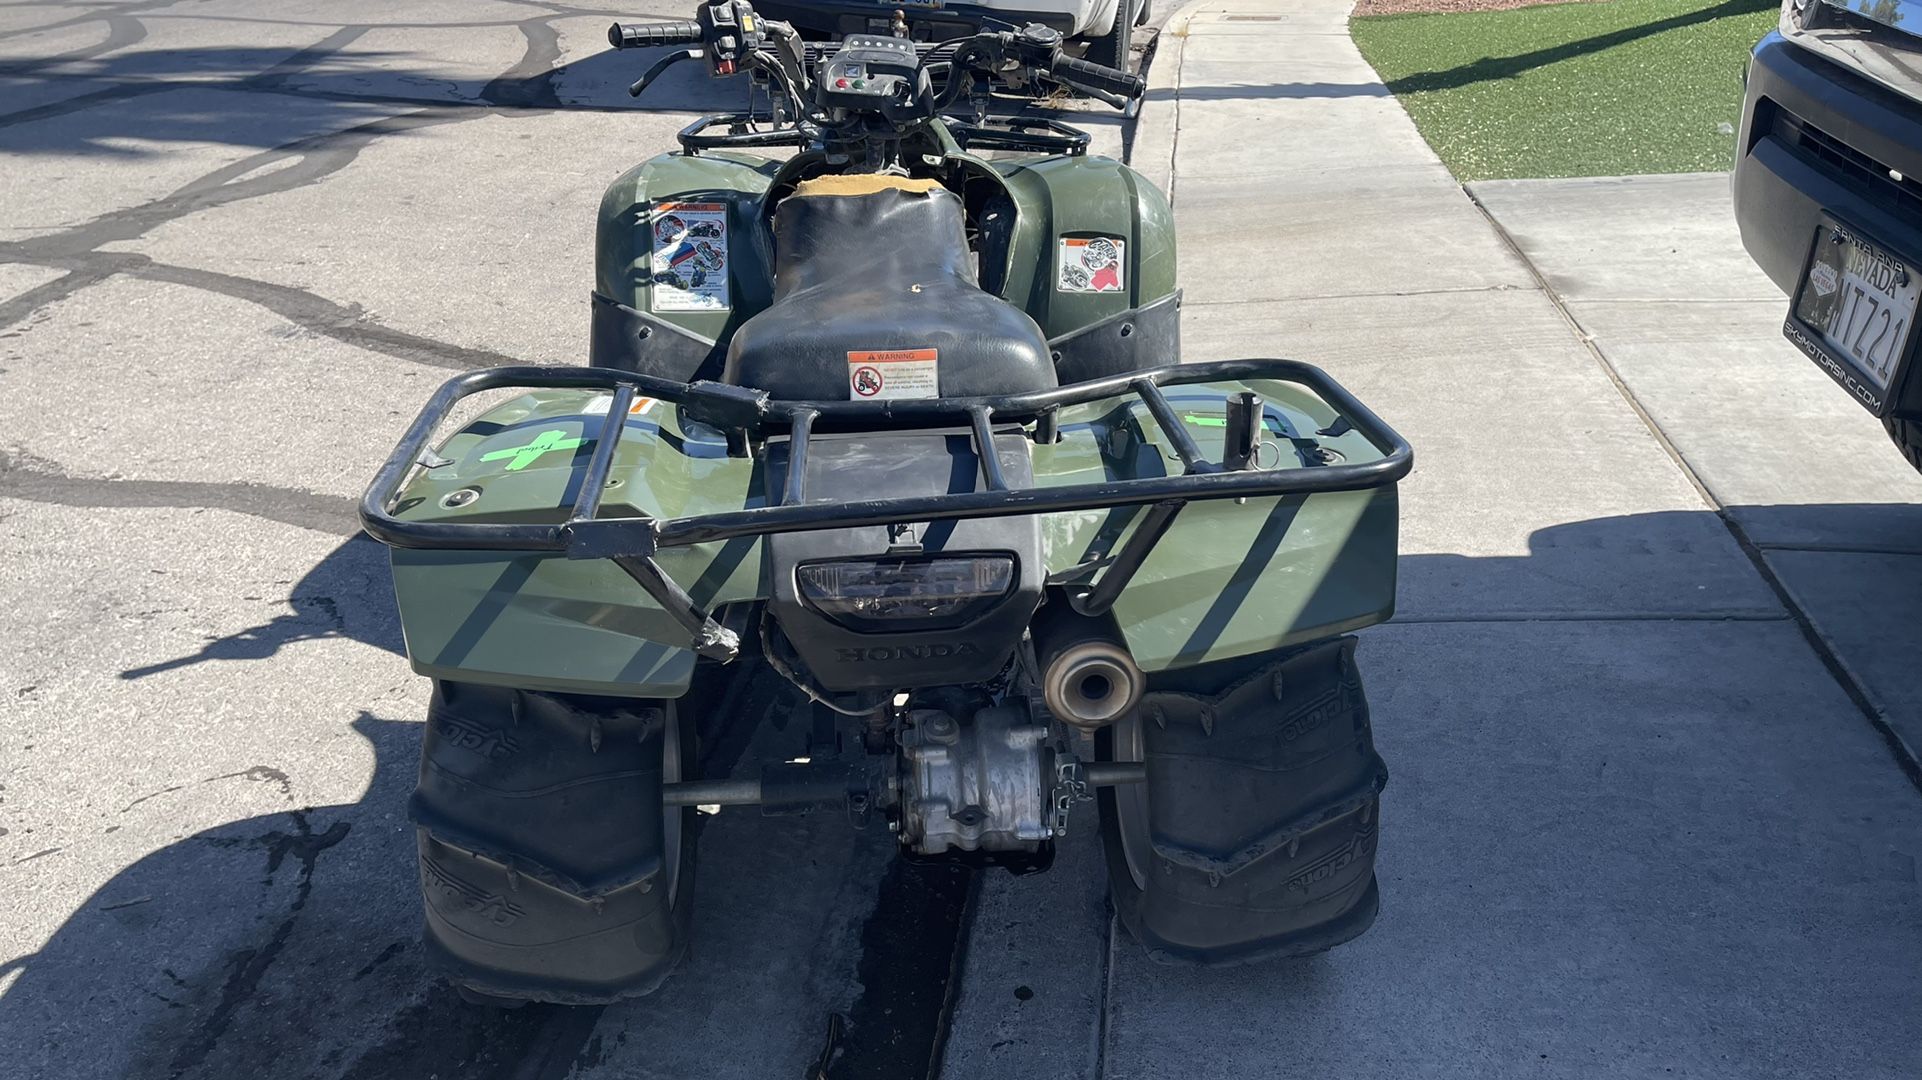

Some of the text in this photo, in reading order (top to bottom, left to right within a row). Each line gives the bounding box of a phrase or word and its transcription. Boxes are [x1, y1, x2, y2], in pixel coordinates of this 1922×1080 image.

[1833, 224, 1903, 273] SANTA ANA
[1846, 245, 1897, 299] NEVADA
[1784, 321, 1881, 411] SKYMOTORSINC.COM
[834, 641, 981, 662] HONDA
